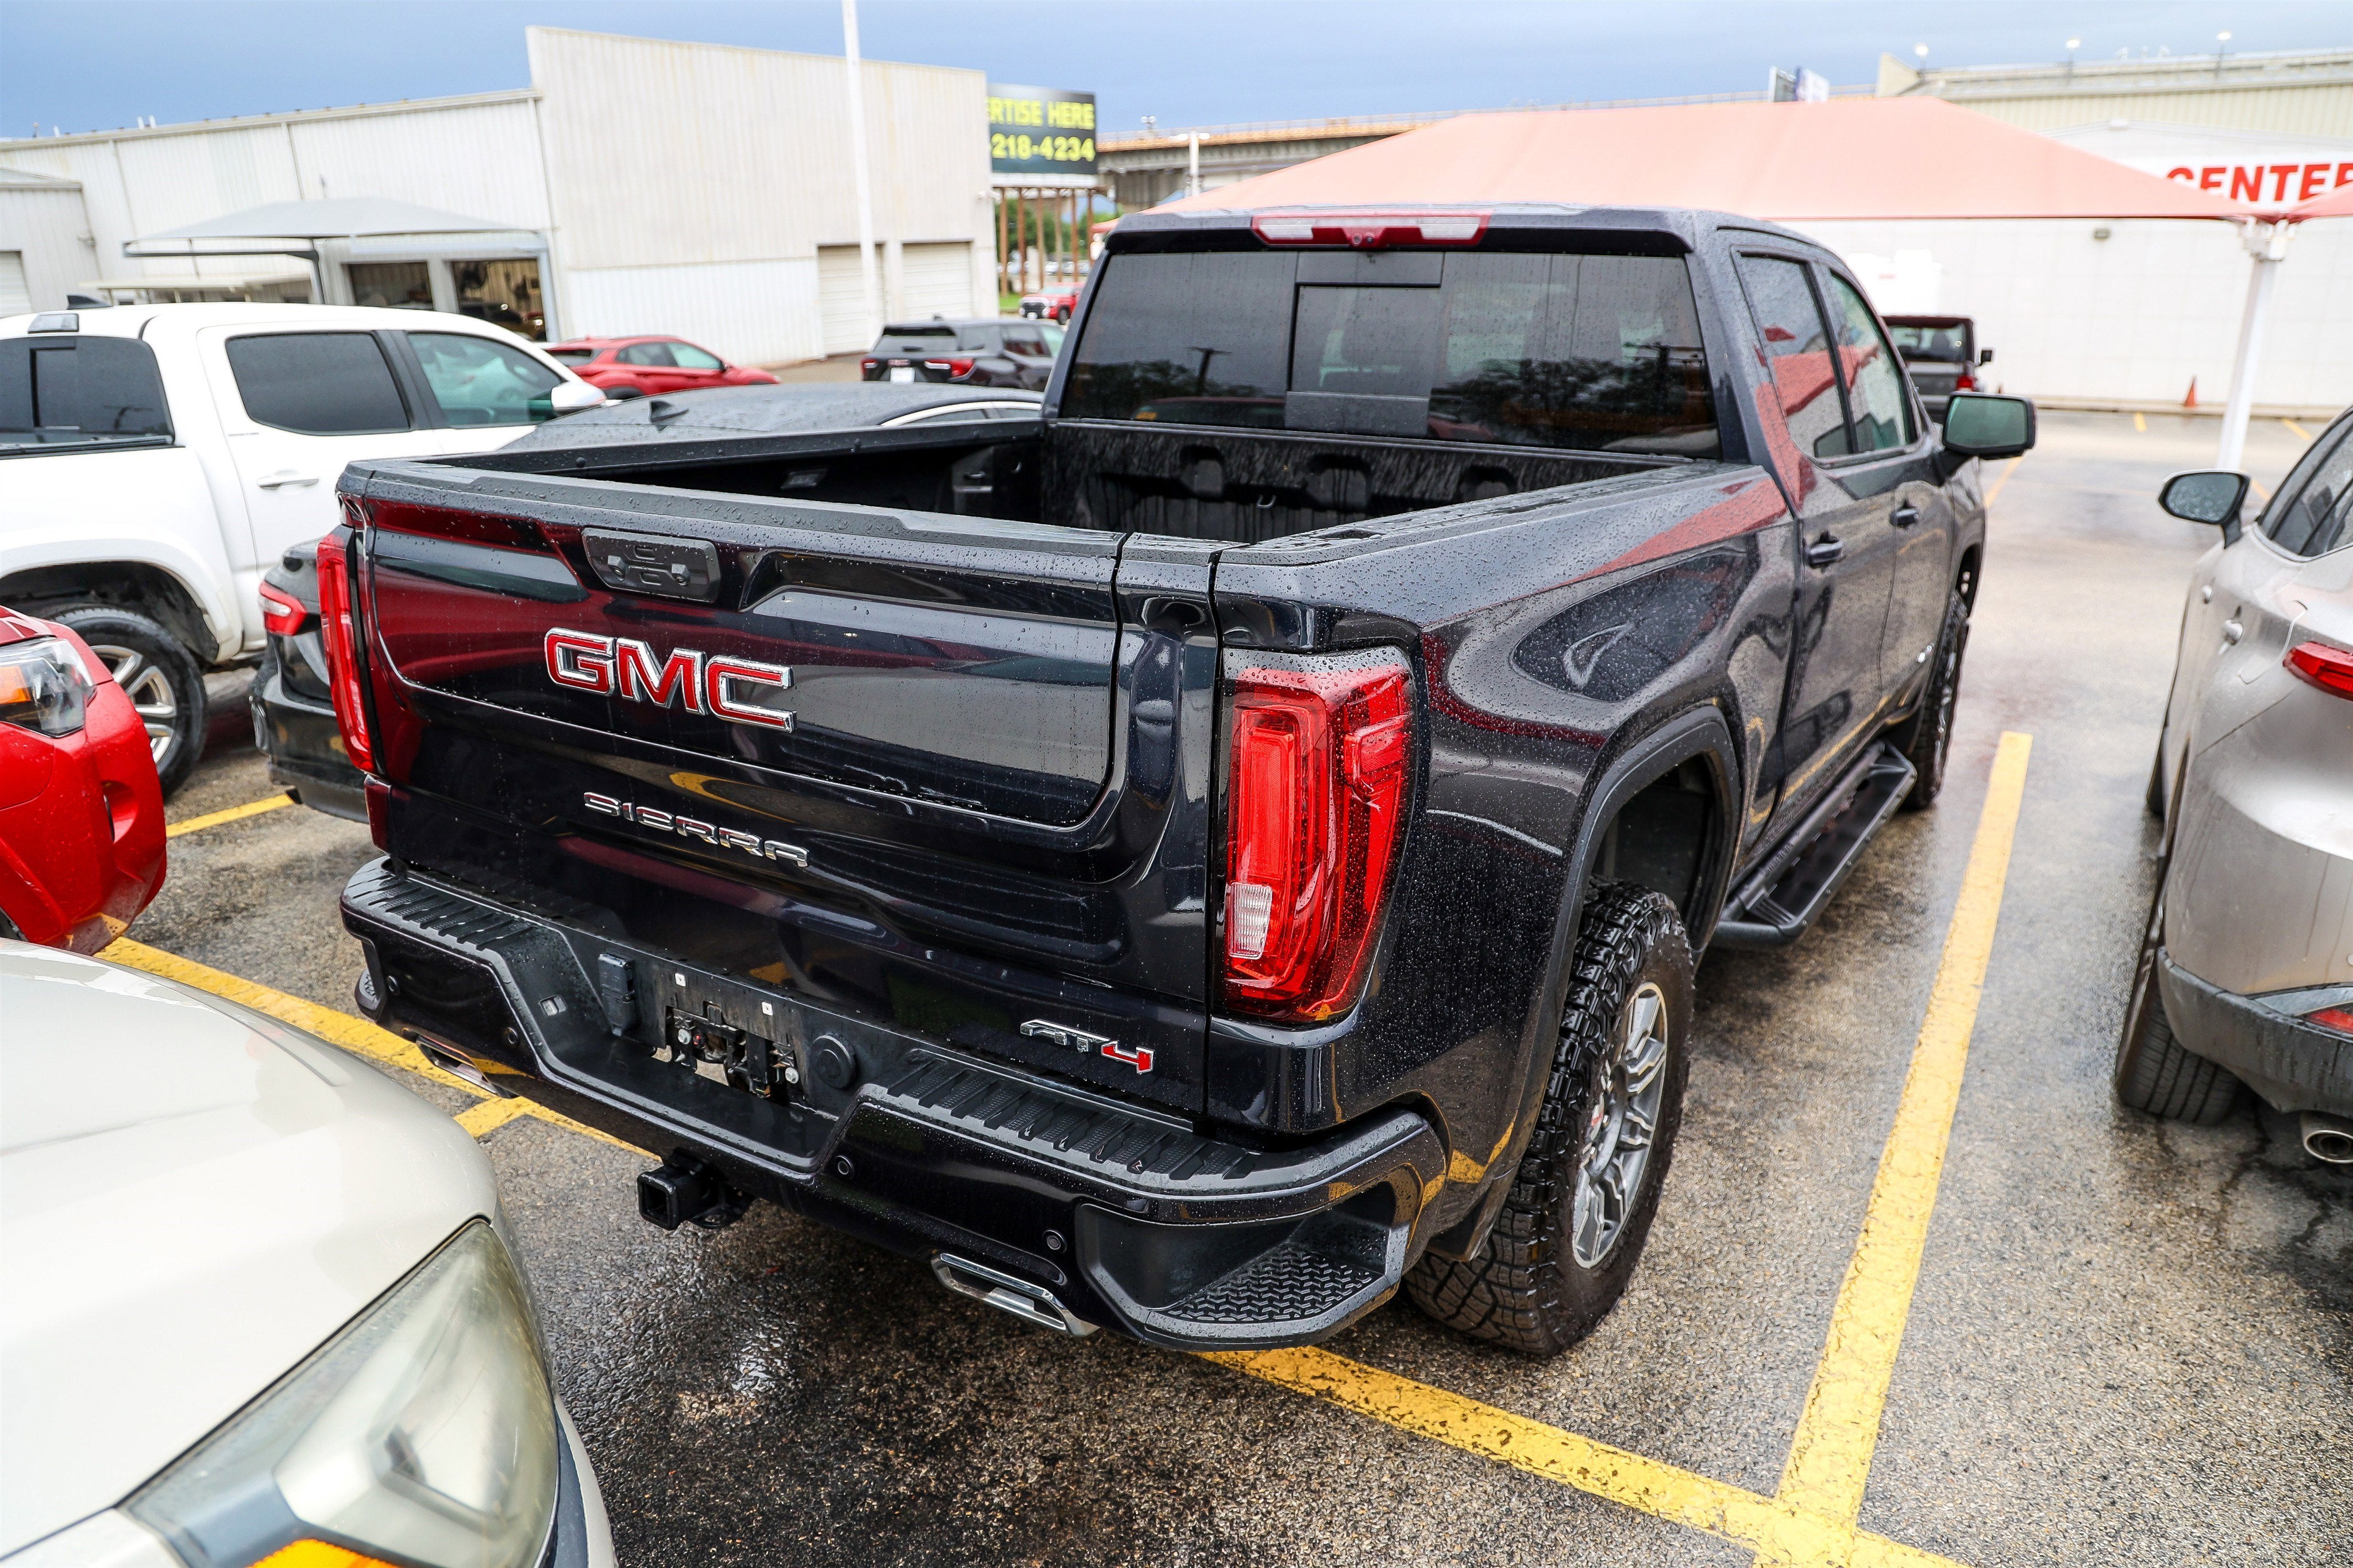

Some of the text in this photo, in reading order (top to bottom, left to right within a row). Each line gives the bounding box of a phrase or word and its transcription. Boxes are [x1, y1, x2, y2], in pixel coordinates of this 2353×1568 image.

[1047, 101, 1096, 130] HERE
[990, 133, 1096, 161] 218-4234
[544, 627, 797, 733] GMC
[583, 791, 809, 867] SIERRA
[1020, 1018, 1155, 1075] AT4
